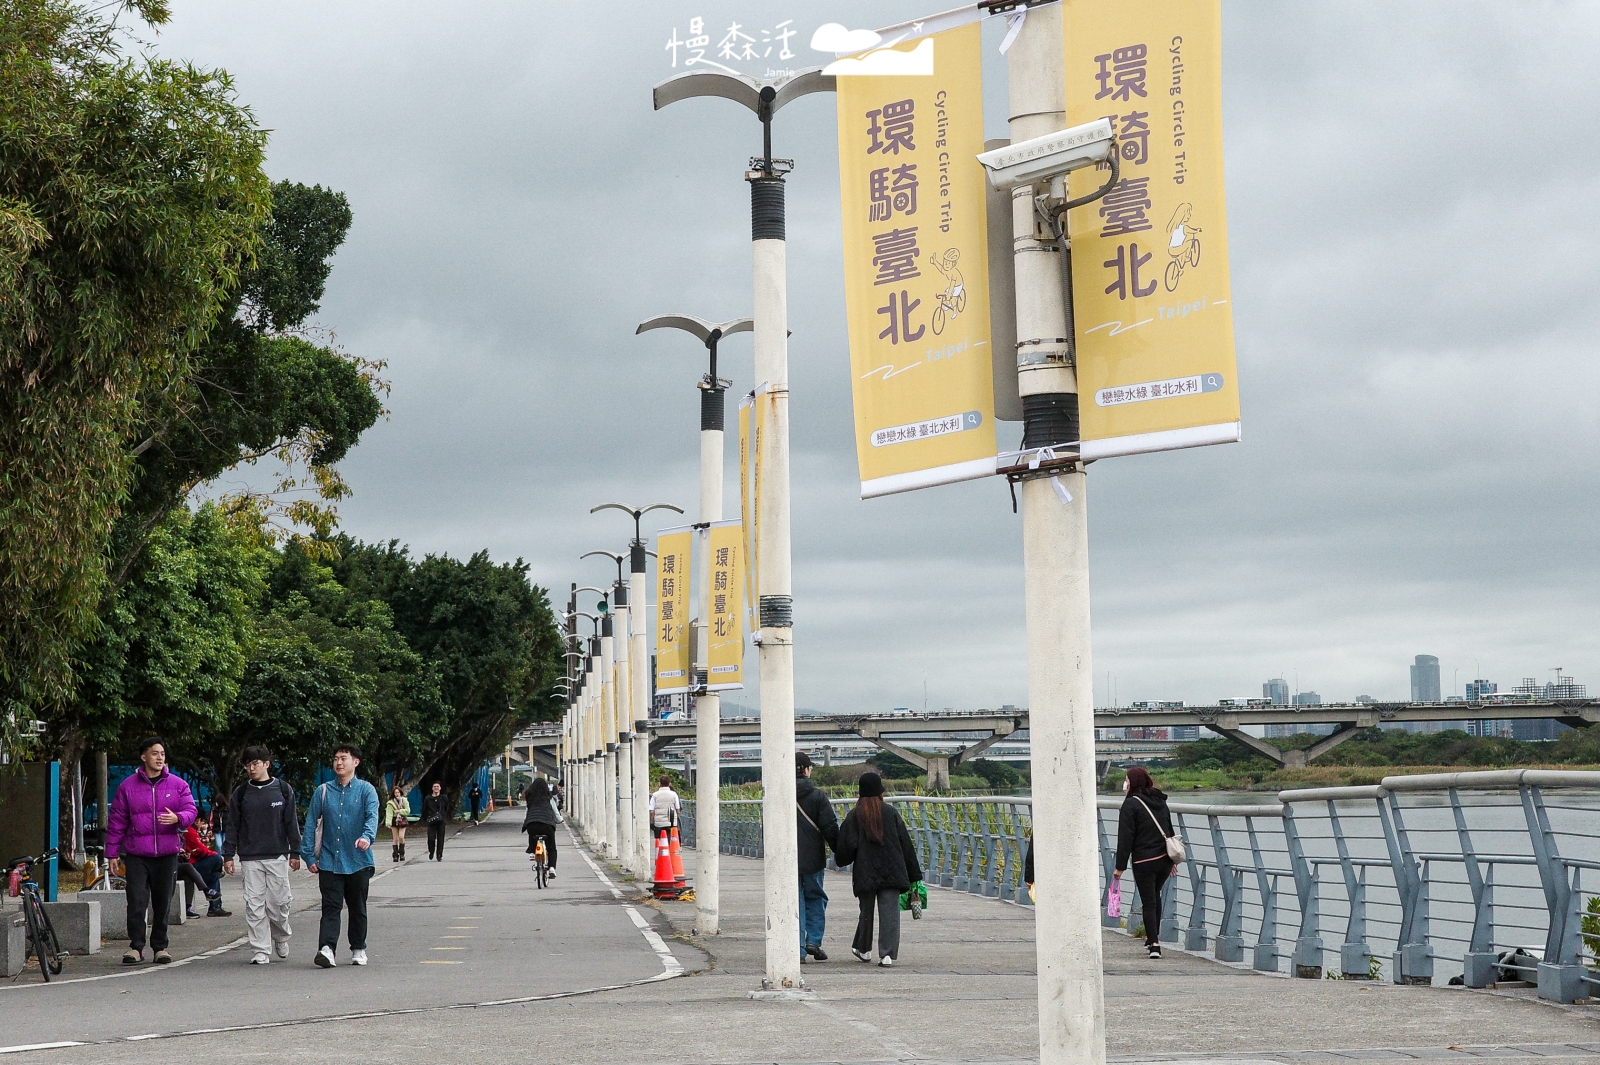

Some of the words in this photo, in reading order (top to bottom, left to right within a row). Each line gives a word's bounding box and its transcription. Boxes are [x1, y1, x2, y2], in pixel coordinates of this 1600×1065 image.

[1169, 35, 1184, 95] Cycling
[935, 90, 949, 148] Cycling
[1173, 100, 1186, 147] Circle
[938, 152, 951, 197] Circle
[1173, 151, 1188, 185] Trip
[866, 99, 926, 345] 環騎臺北
[939, 201, 952, 233] Trip
[1157, 295, 1207, 321] Taipei
[926, 338, 969, 363] Taipei
[1101, 386, 1148, 404] 戀戀水綠
[1150, 378, 1198, 398] 臺北水利
[876, 425, 917, 445] 戀戀水綠
[919, 417, 960, 437] 臺北水利
[662, 554, 675, 642] 環騎臺北
[714, 547, 729, 636] 環騎臺北
